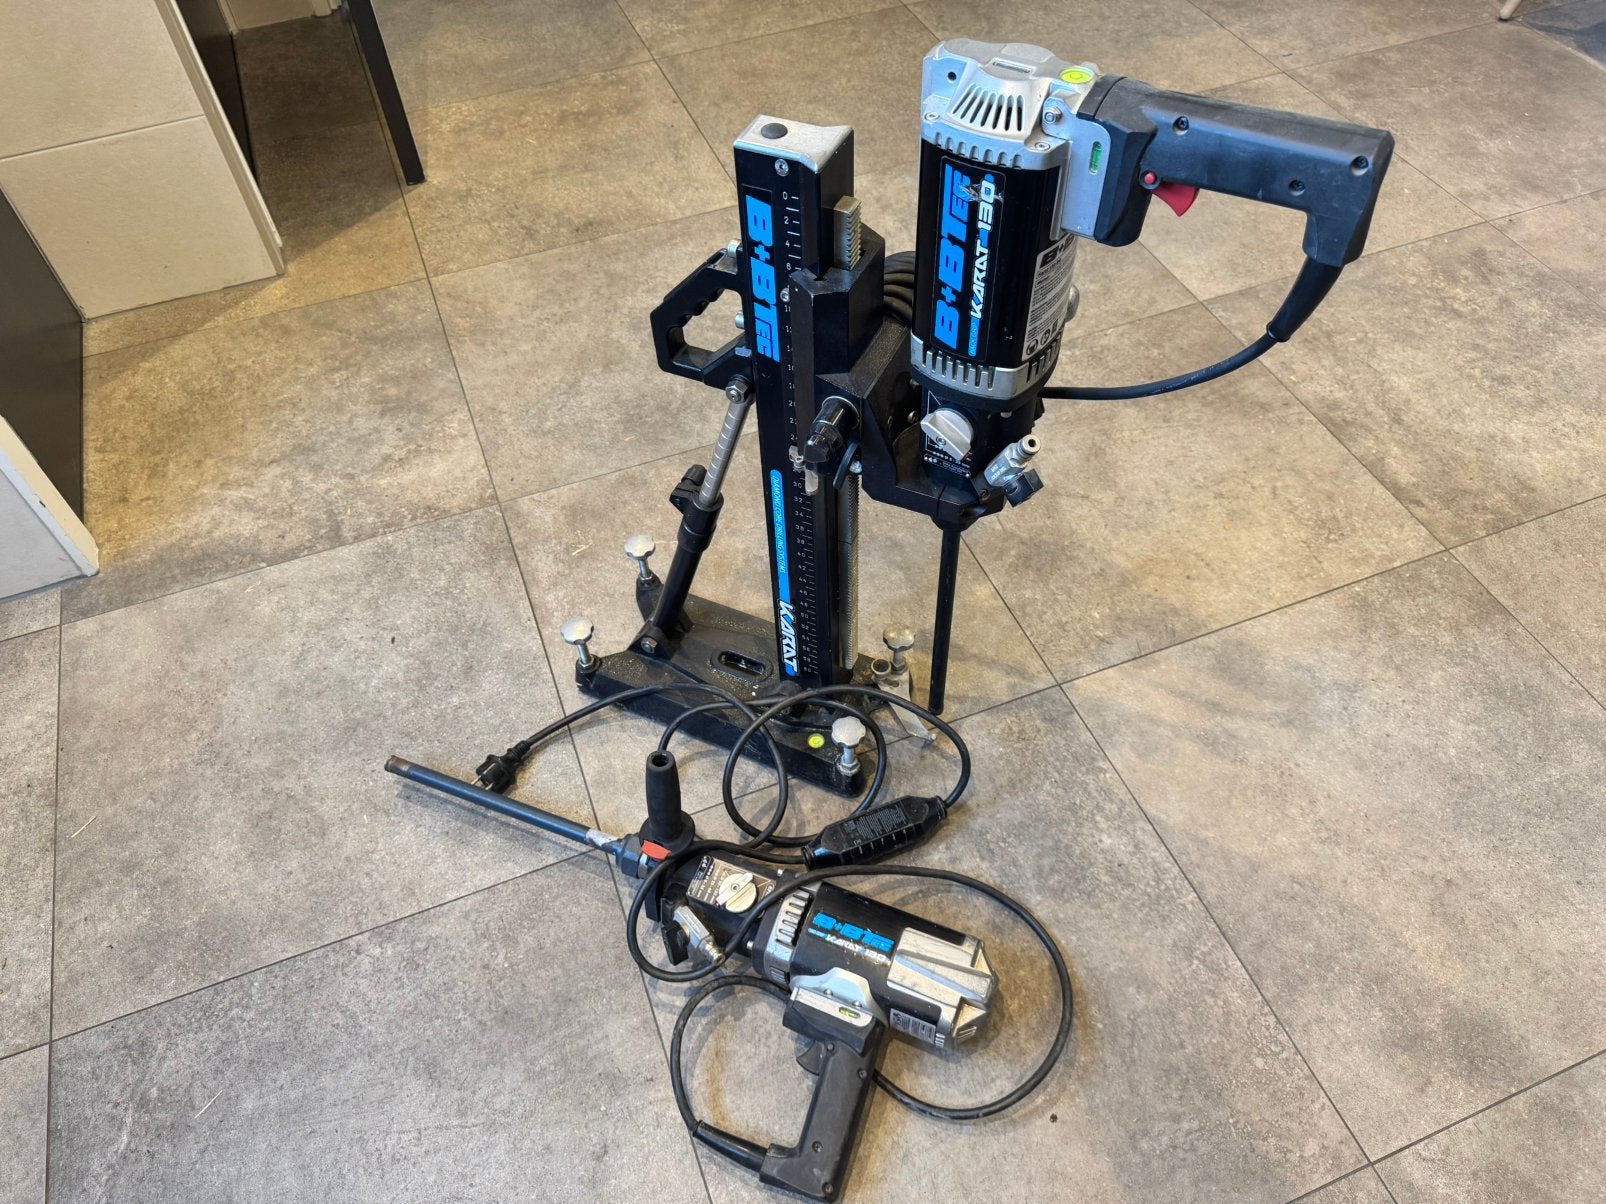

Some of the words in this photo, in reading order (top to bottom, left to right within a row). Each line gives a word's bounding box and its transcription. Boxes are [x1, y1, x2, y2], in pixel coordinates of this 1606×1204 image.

[782, 191, 788, 200] 0
[977, 179, 996, 231] 130
[783, 216, 789, 225] 2
[785, 240, 790, 248] 4
[970, 239, 990, 319] KARAT
[794, 496, 803, 504] 32
[779, 600, 797, 673] KARAT
[825, 933, 862, 953] KARAT
